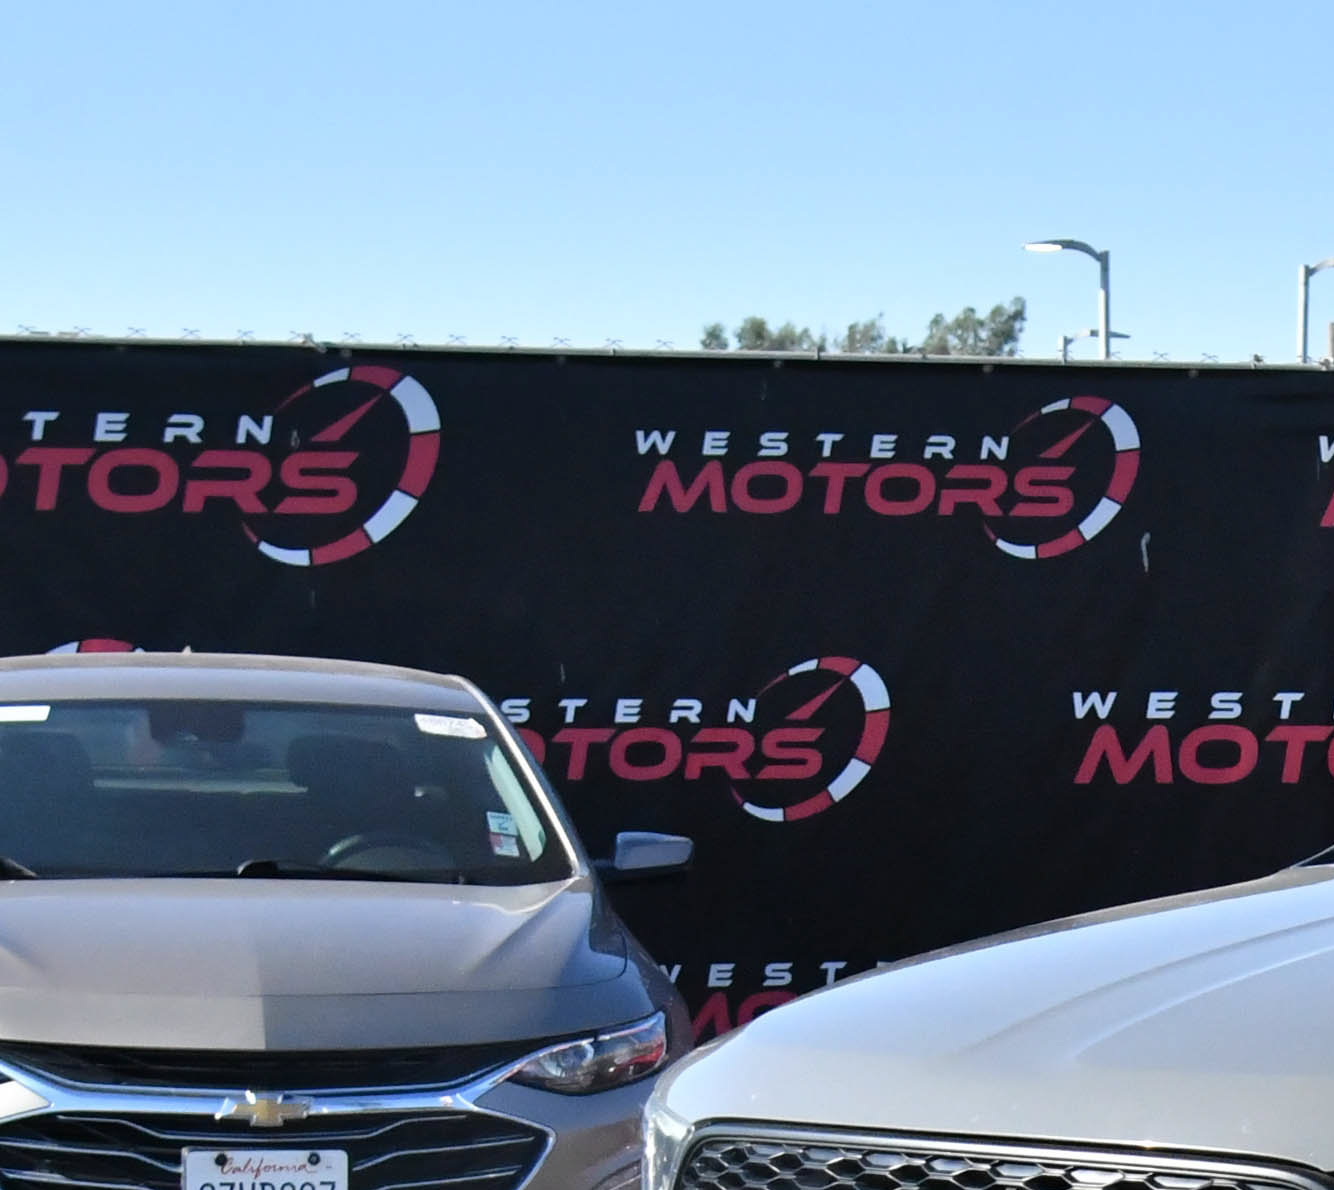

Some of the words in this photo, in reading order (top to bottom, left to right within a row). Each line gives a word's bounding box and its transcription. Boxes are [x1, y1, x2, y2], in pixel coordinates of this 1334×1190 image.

[22, 411, 274, 444] TERN
[635, 429, 1010, 461] WESTERN
[638, 460, 1077, 517] MOTORS
[501, 698, 757, 724] STERN
[221, 1157, 318, 1180] California
